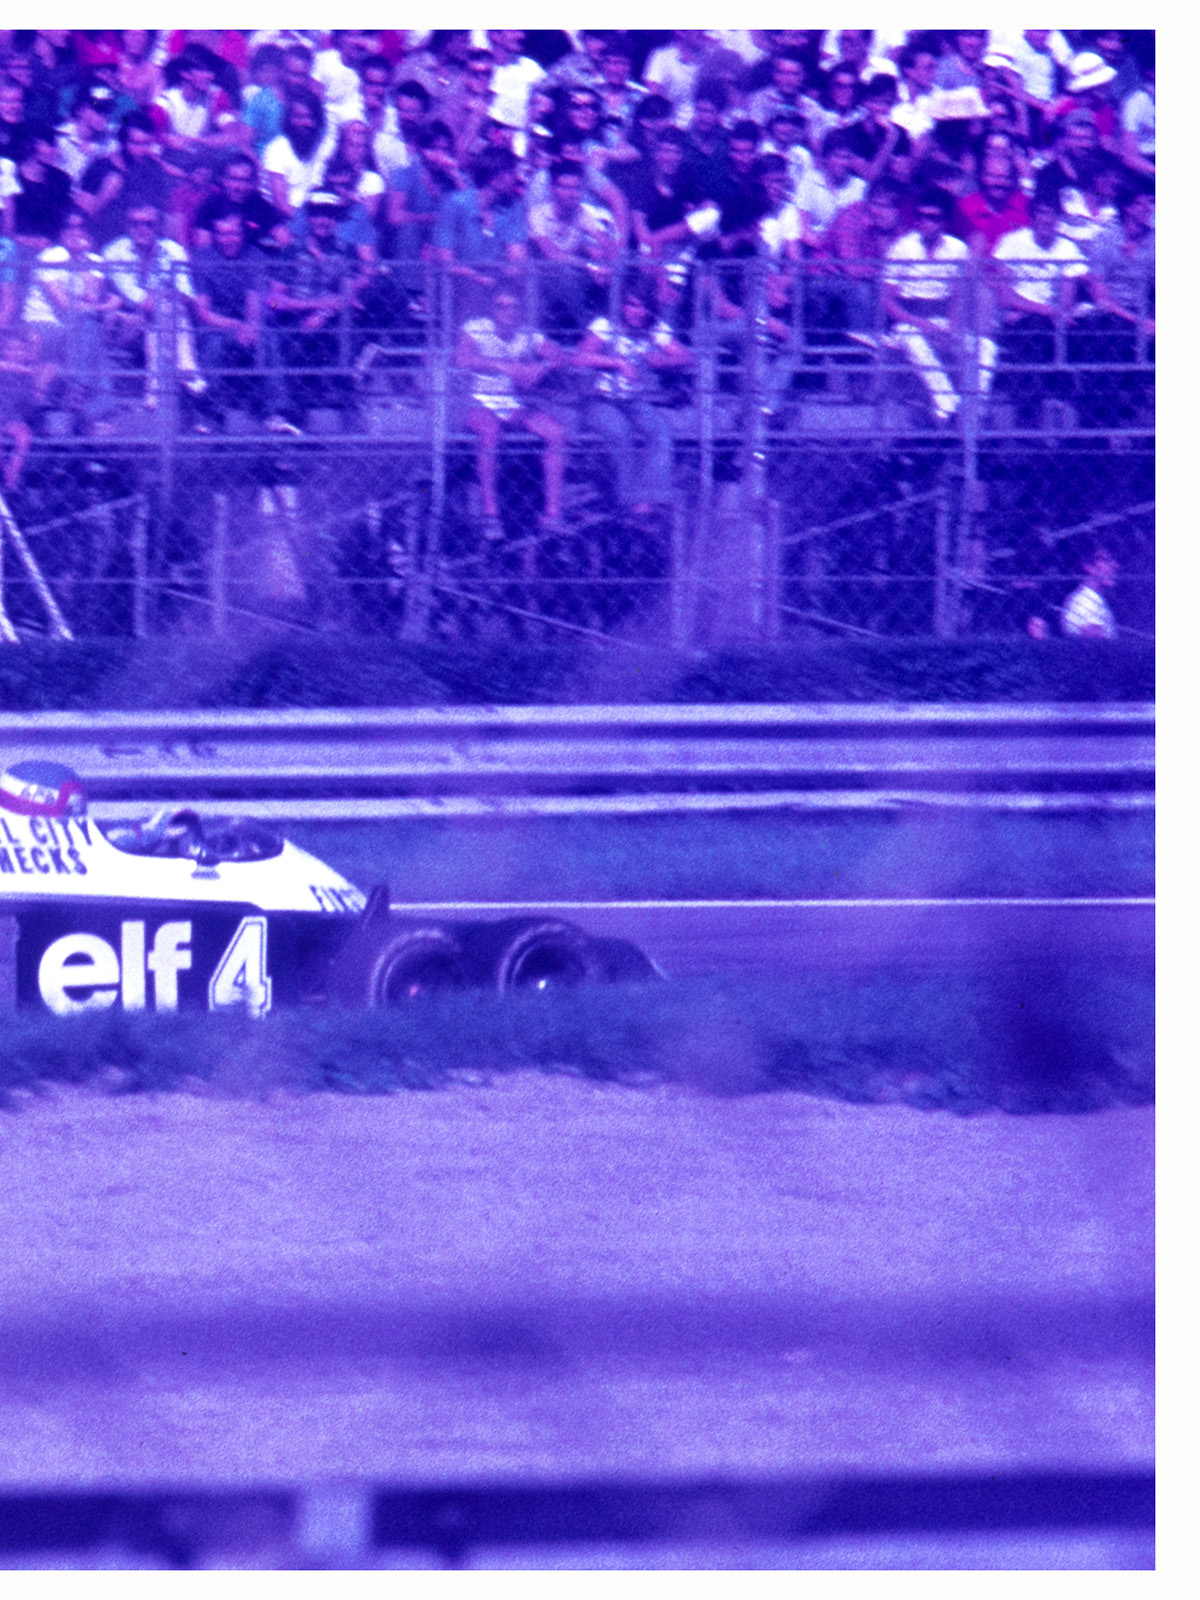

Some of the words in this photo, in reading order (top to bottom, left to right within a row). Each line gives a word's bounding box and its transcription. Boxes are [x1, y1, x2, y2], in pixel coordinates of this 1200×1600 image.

[28, 816, 93, 847] CITY
[38, 920, 192, 1017] elf
[208, 916, 271, 1019] 4
